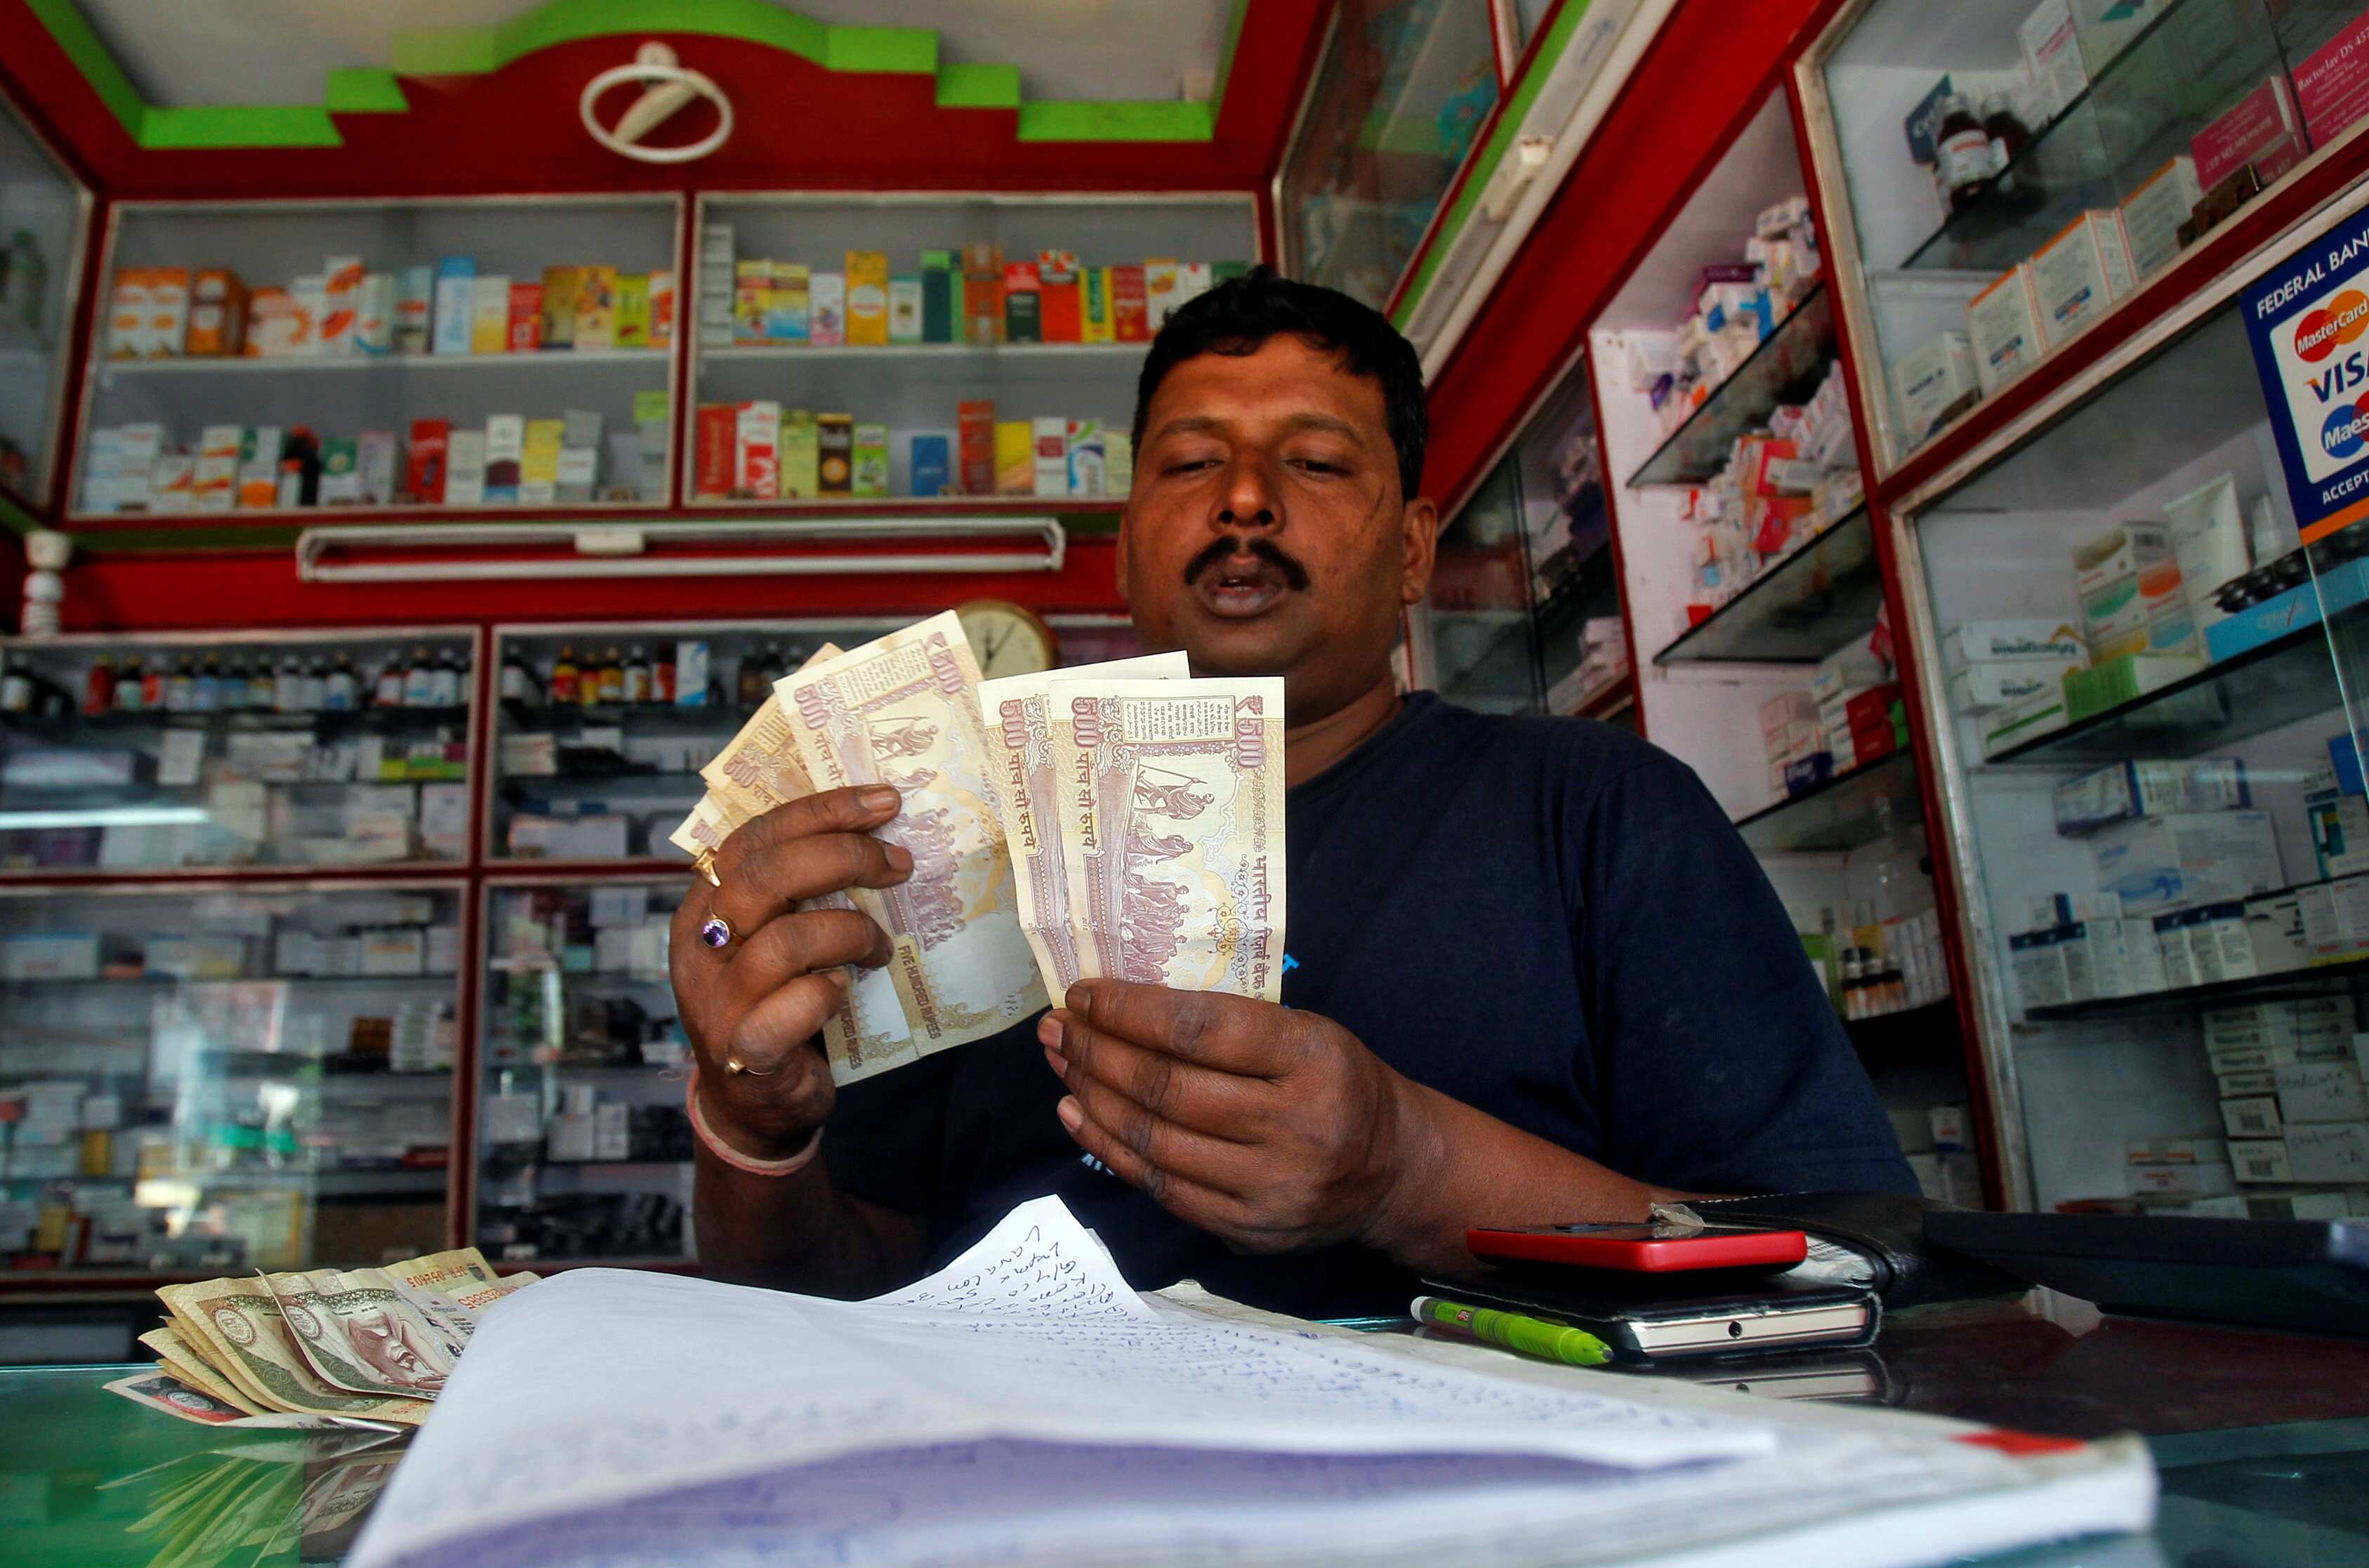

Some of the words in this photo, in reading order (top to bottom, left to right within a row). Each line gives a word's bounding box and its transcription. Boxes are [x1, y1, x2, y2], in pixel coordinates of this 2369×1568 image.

[2257, 263, 2326, 319] FEDERAL
[2329, 225, 2369, 272] BAN
[2297, 298, 2369, 355] MasterCard
[999, 697, 1025, 750] 500
[1071, 696, 1099, 749] 500
[1252, 855, 1272, 921] भारतीय
[898, 944, 916, 967] FIVE
[905, 964, 930, 1006] HUNDRED
[920, 1004, 942, 1040] RUPEES
